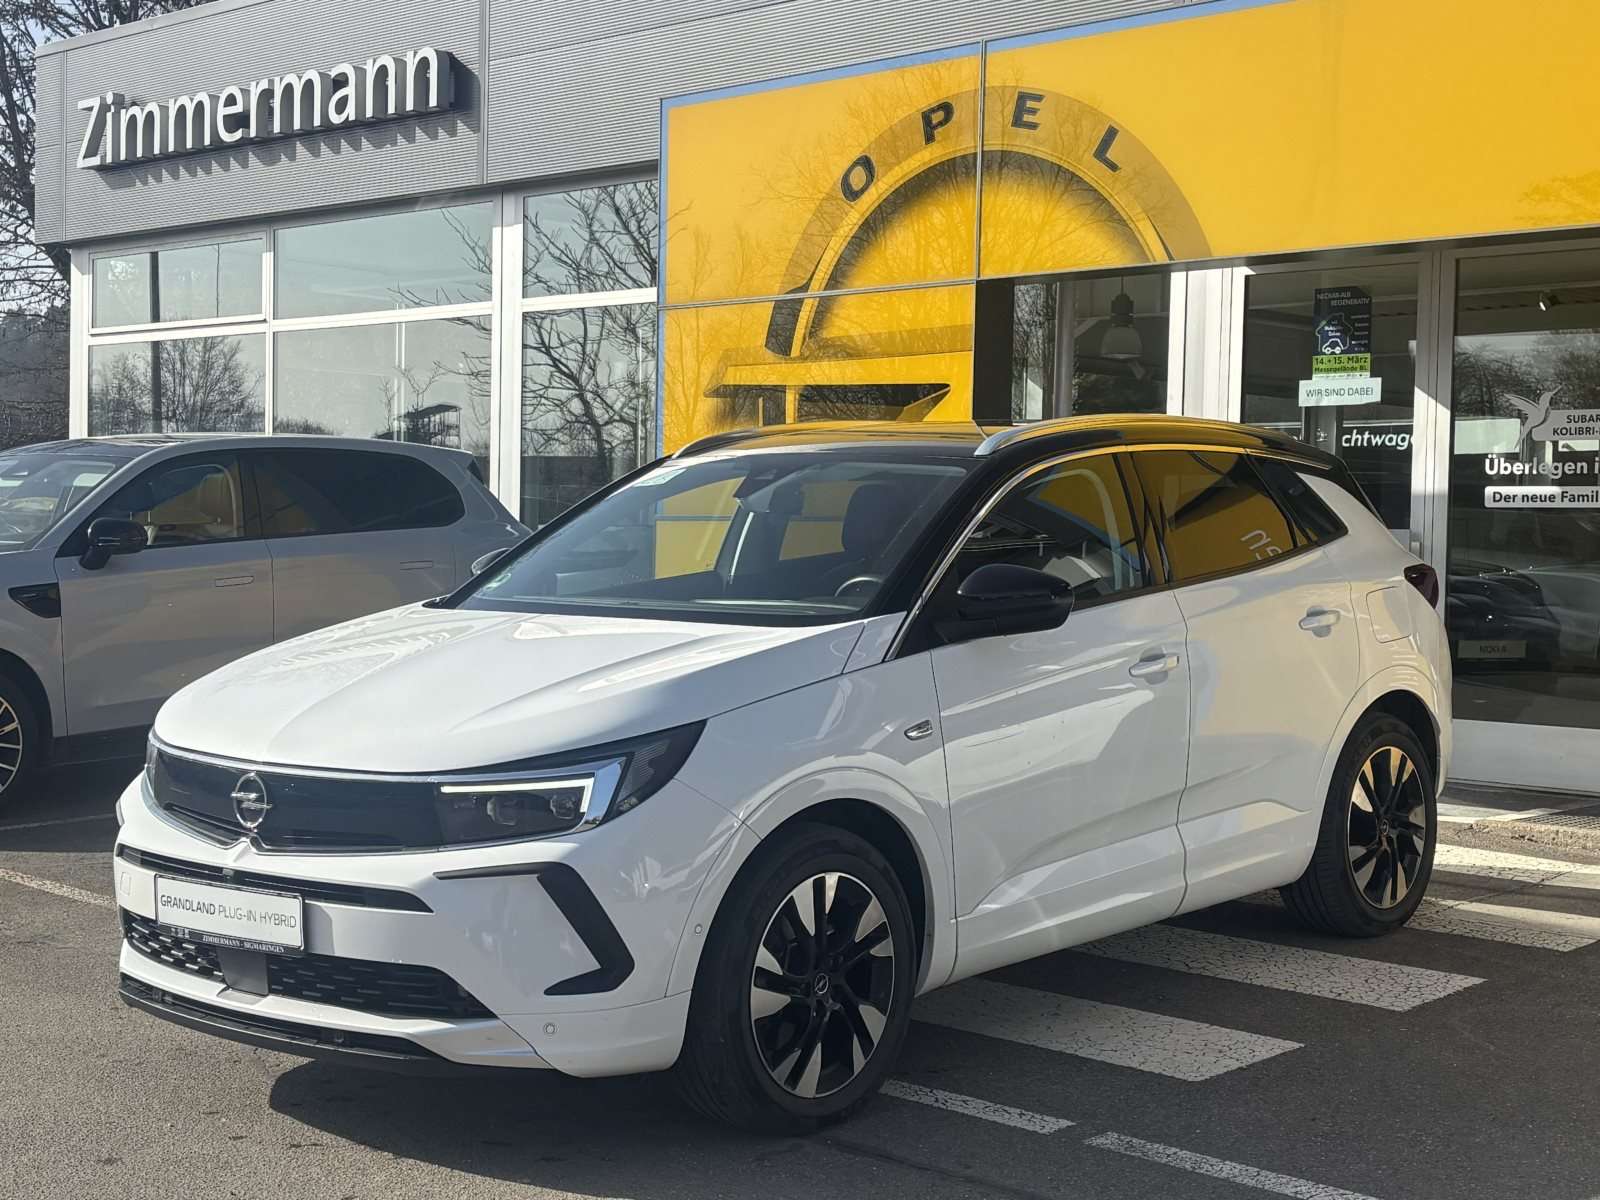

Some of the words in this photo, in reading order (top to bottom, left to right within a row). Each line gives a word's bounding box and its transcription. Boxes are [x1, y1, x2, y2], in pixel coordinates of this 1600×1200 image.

[76, 46, 441, 170] Zimmermann
[839, 89, 1123, 204] OPEL
[1347, 355, 1369, 364] März
[1305, 389, 1323, 398] WIR
[1324, 388, 1346, 397] SIND
[1347, 387, 1374, 396] DABEI
[1553, 426, 1600, 436] KOLIBRI-
[1485, 454, 1588, 479] Überlegen
[1492, 491, 1518, 503] Der
[1521, 493, 1556, 503] neue
[1560, 490, 1599, 503] Famil
[160, 894, 216, 916] GRANDLAND
[218, 904, 257, 923] PLUG-IN
[259, 911, 297, 929] HYBRID
[202, 934, 240, 947] ZIMMERMANN
